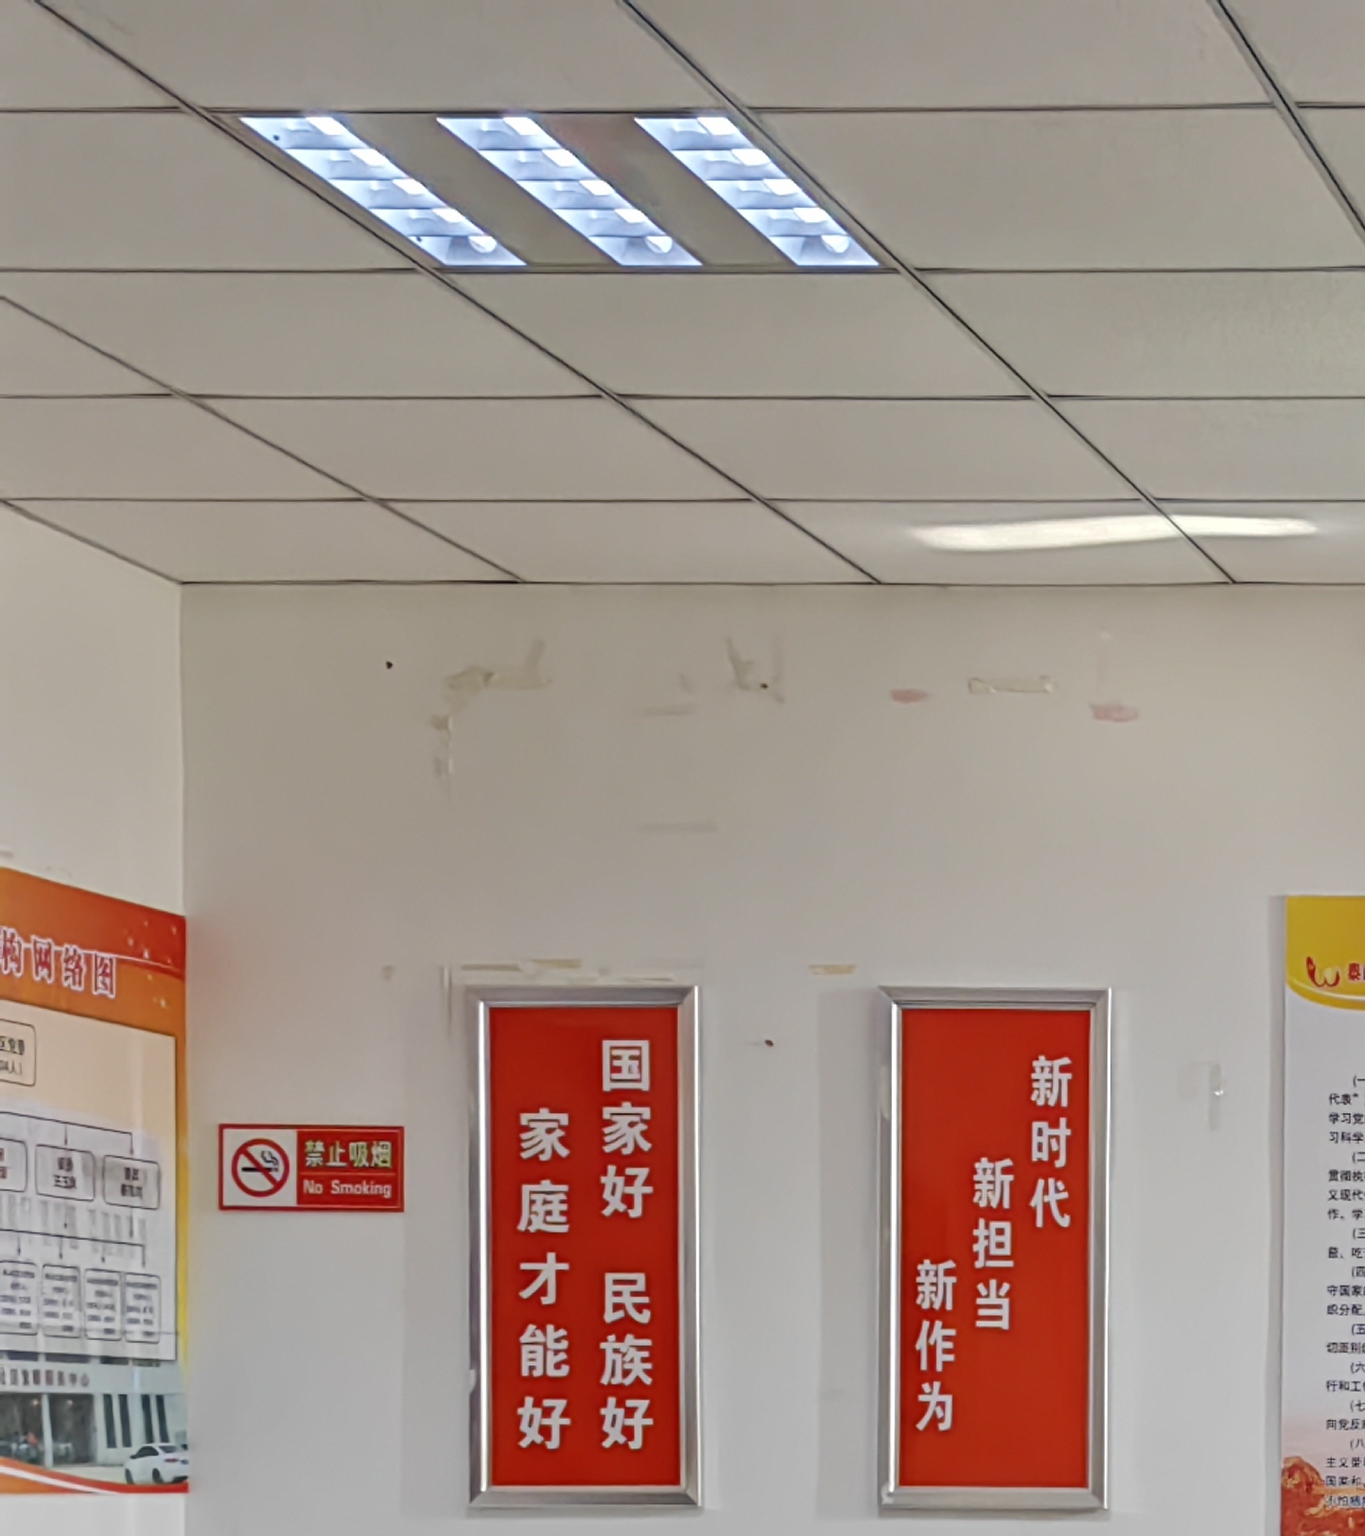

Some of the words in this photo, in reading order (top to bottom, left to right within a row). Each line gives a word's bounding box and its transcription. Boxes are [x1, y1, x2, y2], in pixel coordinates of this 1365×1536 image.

[303, 1179, 323, 1195] No
[331, 1179, 392, 1199] Smoking
[305, 1140, 392, 1168] 禁止吸烟
[601, 1039, 653, 1218] 国家好
[1030, 1056, 1072, 1228] 新时代
[517, 1108, 571, 1450] 家庭才能好
[973, 1158, 1014, 1330] 新担当
[600, 1273, 653, 1450] 民族好
[915, 1260, 956, 1432] 新作为
